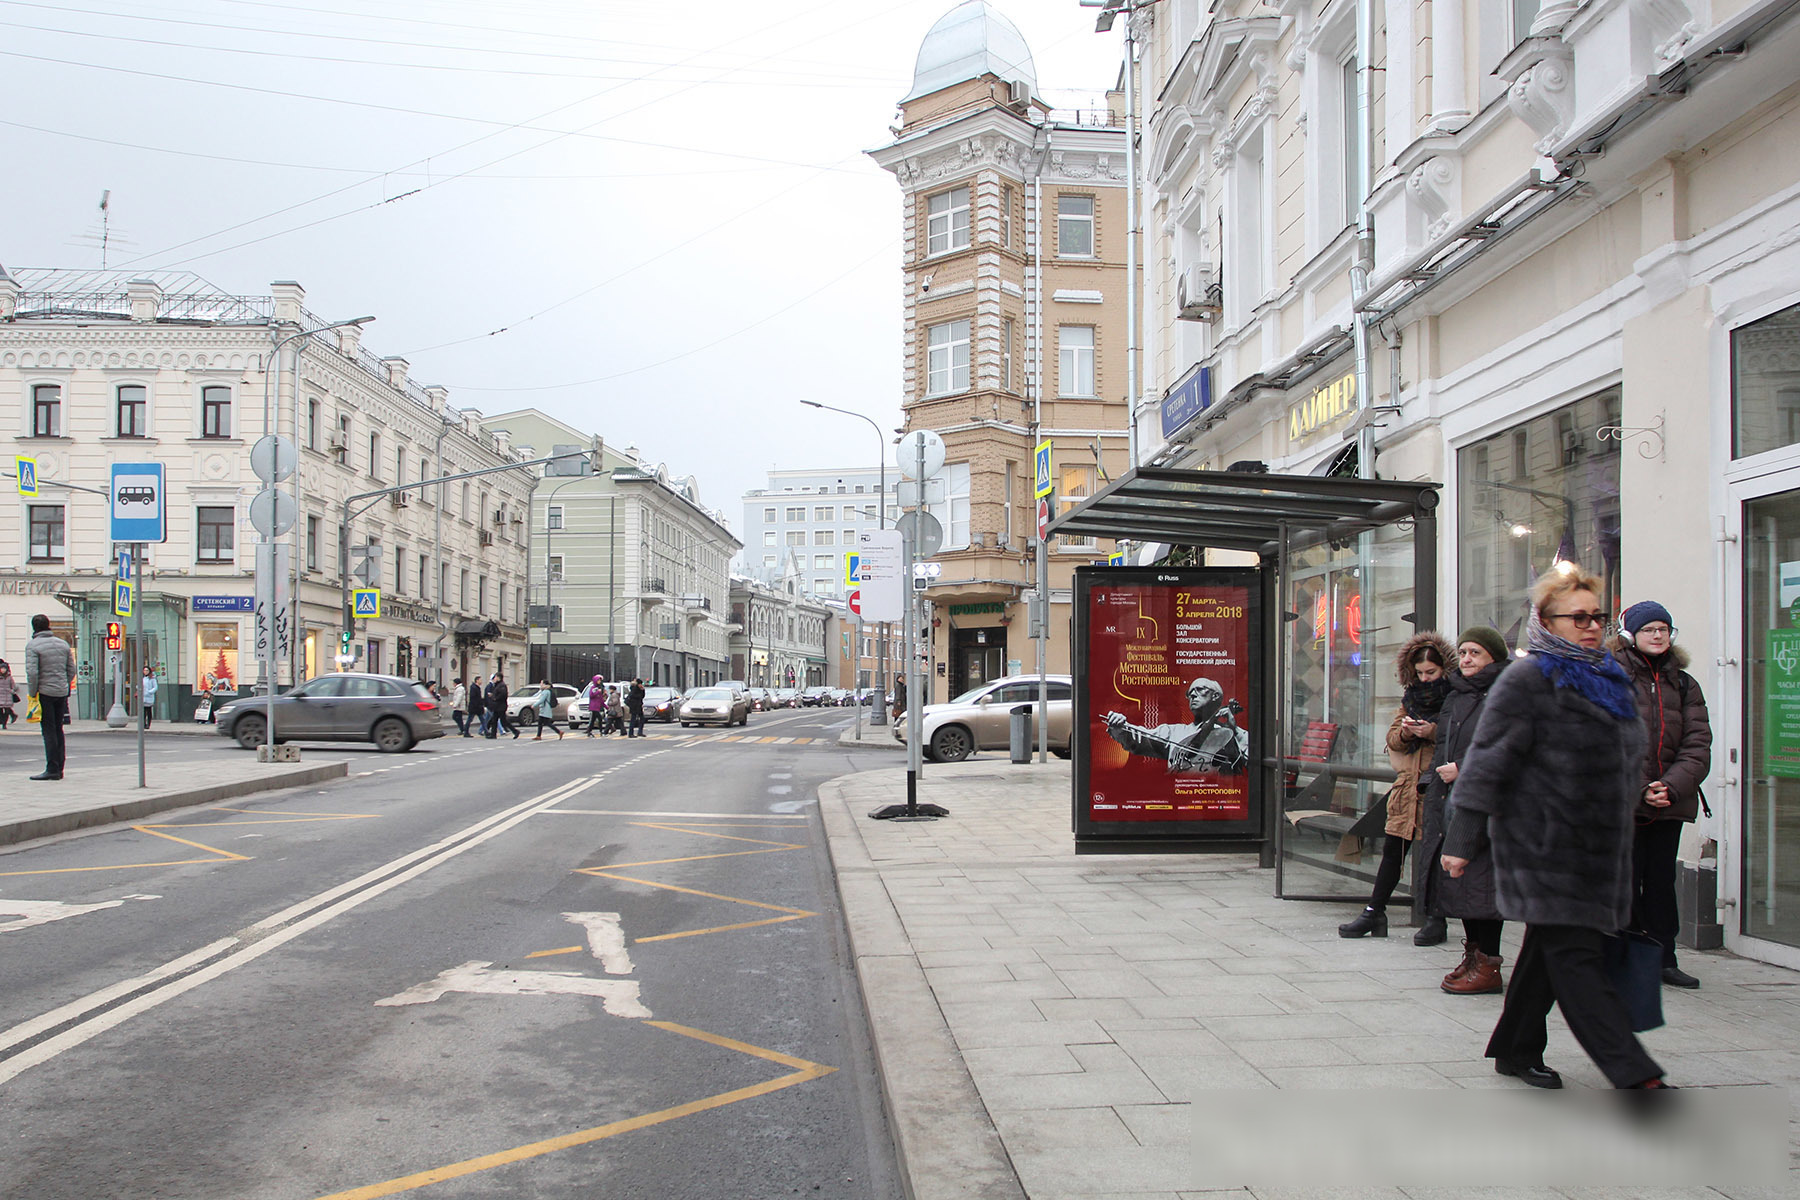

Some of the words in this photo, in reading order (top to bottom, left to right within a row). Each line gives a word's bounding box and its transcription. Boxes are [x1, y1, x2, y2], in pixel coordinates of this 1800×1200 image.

[1194, 380, 1199, 405] 1
[1289, 374, 1356, 441] ДАЙНЕР
[243, 598, 250, 608] 2
[1176, 593, 1191, 605] 27
[949, 602, 1004, 615] ПРОДУКТЫ
[1176, 606, 1184, 618] 3
[1216, 606, 1242, 618] 2018
[1136, 627, 1145, 639] IX
[108, 639, 120, 649] 51
[1121, 674, 1180, 685] Ростроповича
